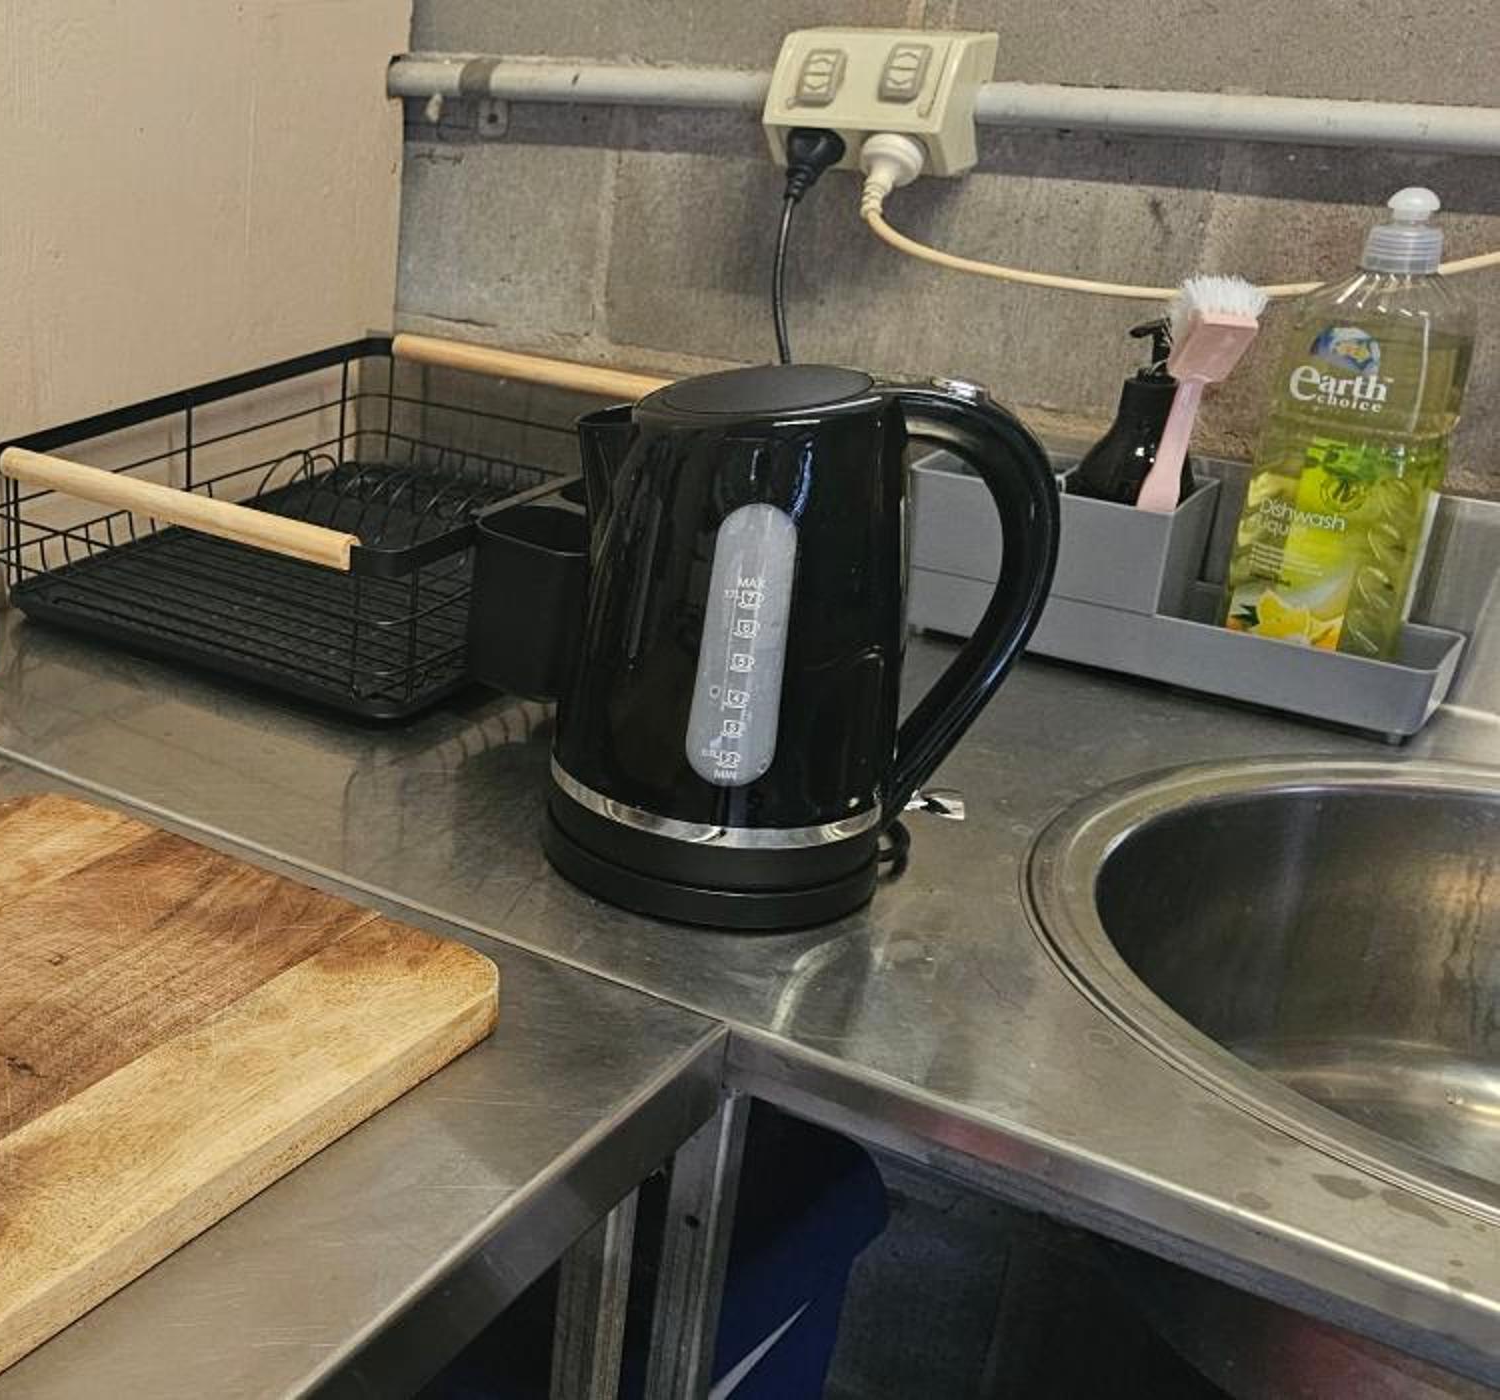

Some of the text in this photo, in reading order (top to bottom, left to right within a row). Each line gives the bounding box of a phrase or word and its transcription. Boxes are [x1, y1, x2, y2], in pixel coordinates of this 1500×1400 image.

[1289, 365, 1387, 402] earth
[1317, 394, 1383, 413] choice
[1260, 496, 1346, 532] Dishwash
[738, 577, 766, 589] MAX
[713, 768, 737, 780] MIN
